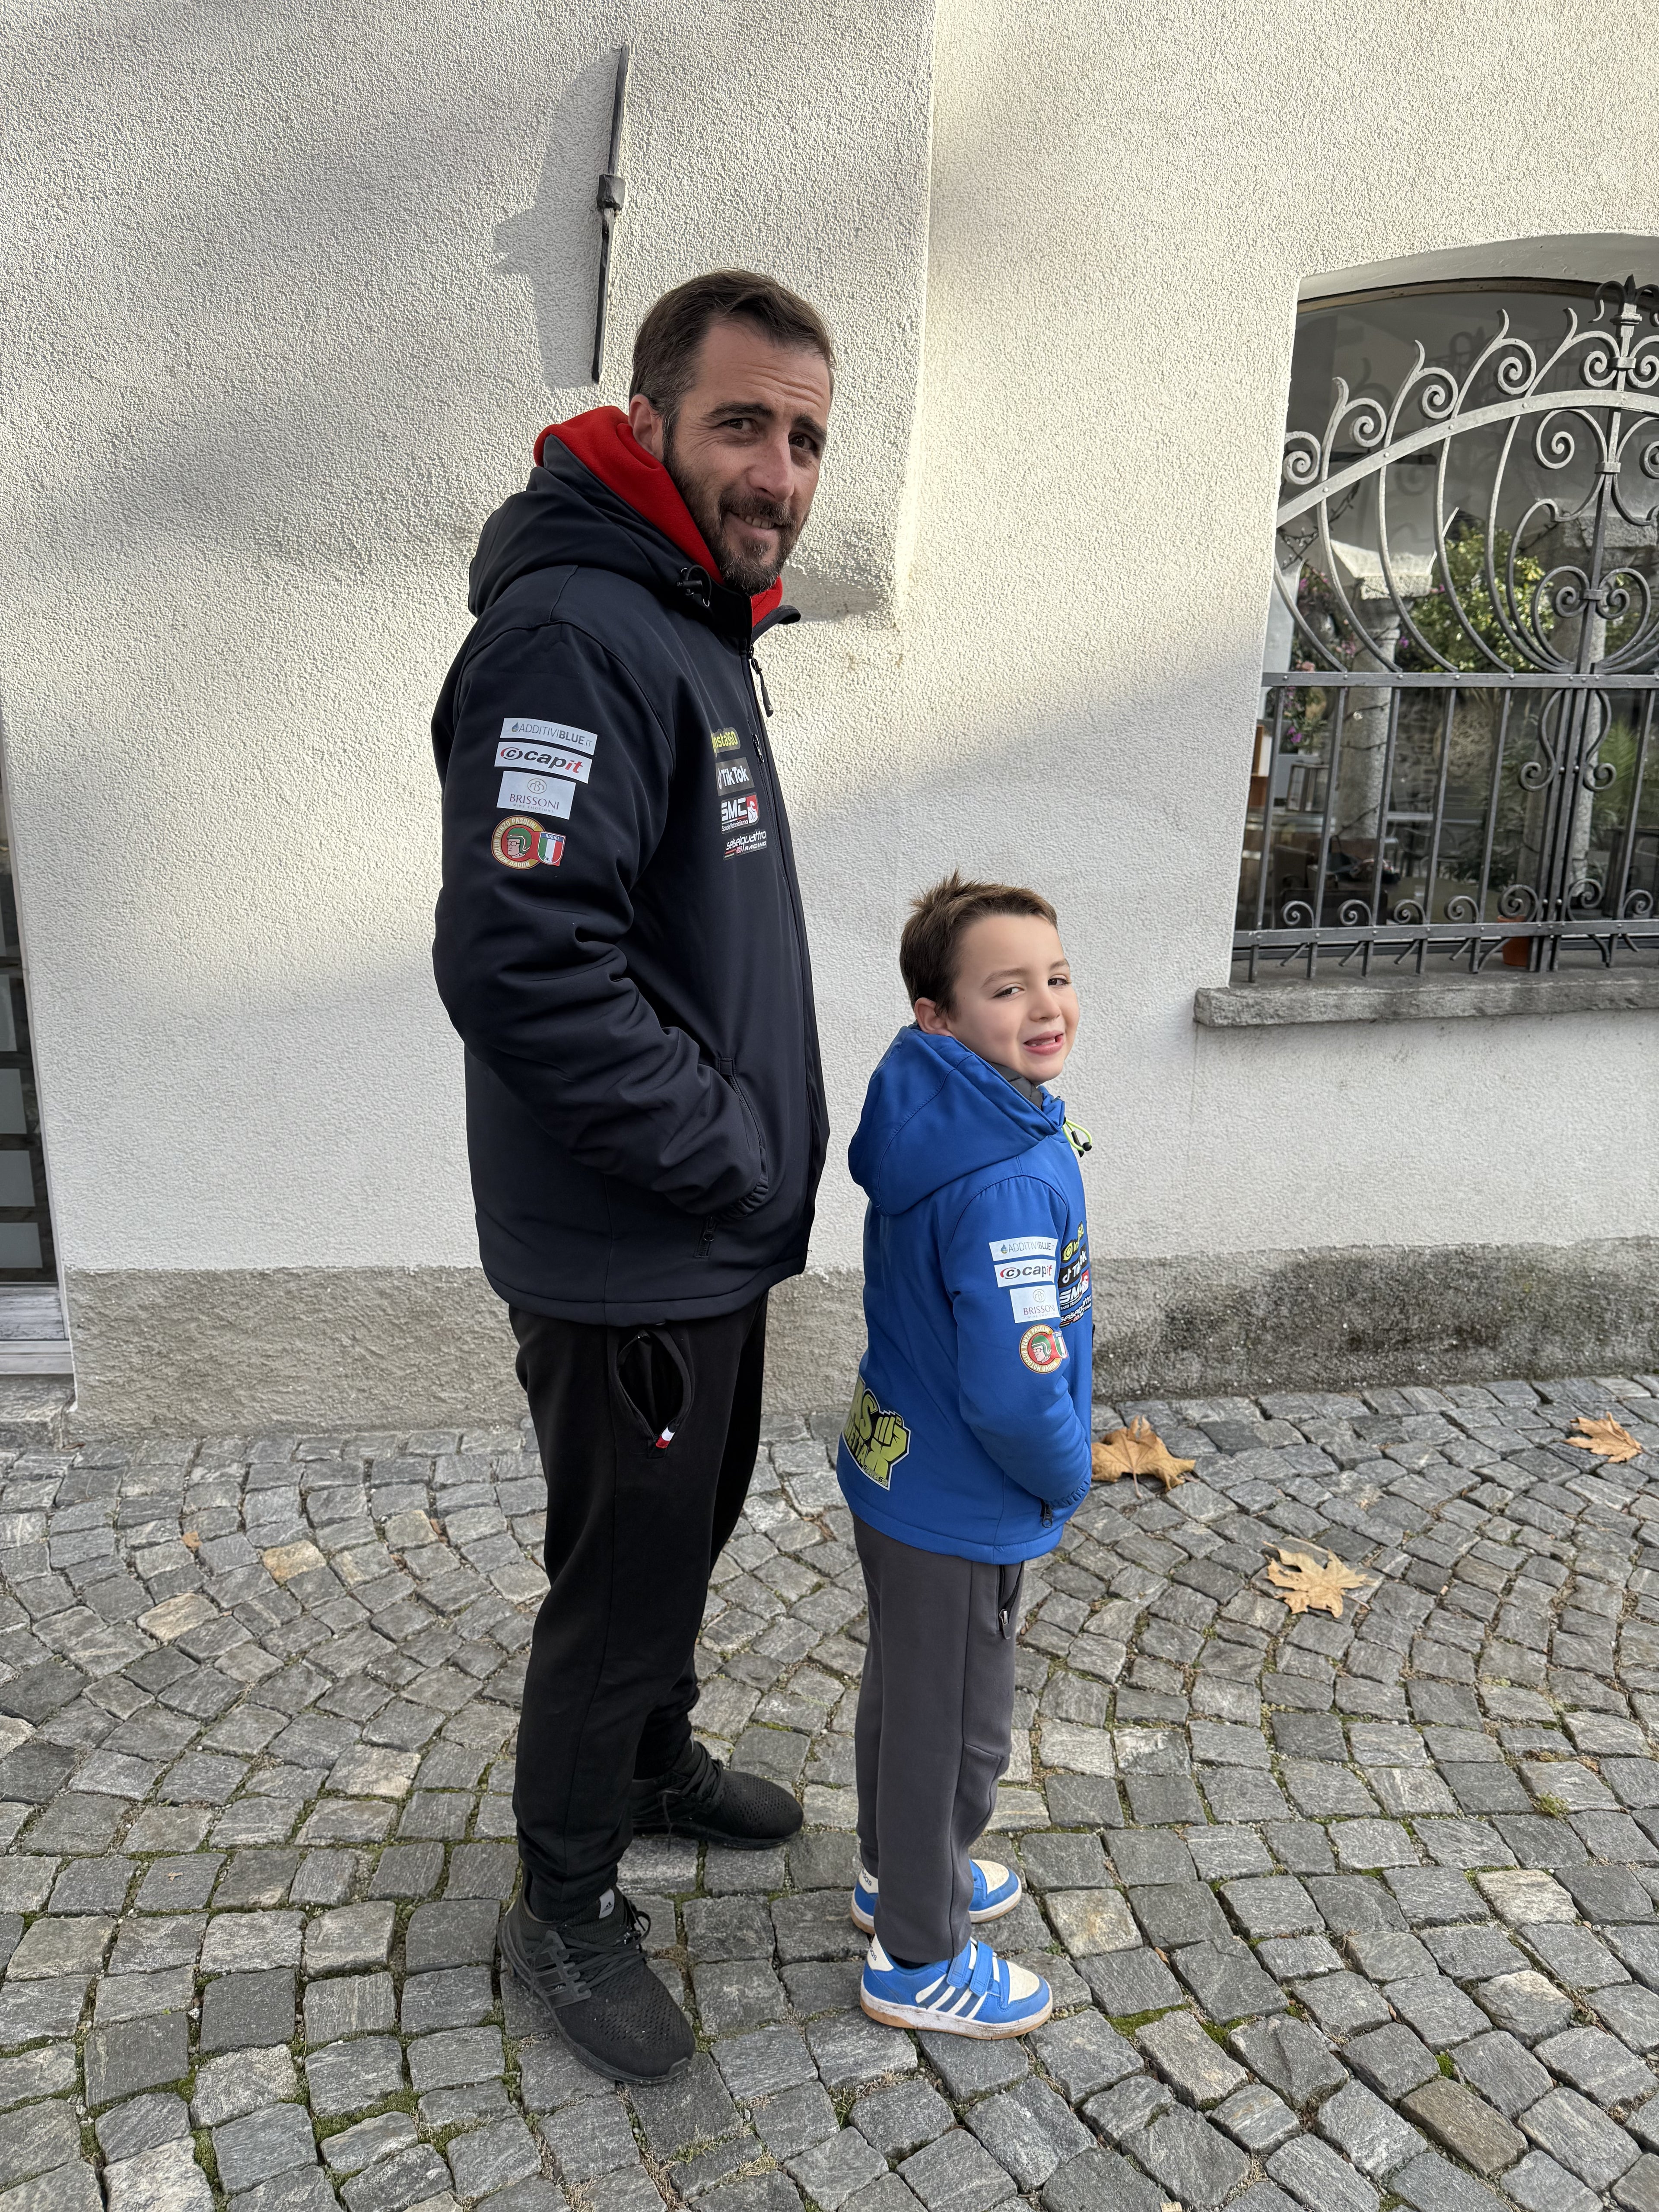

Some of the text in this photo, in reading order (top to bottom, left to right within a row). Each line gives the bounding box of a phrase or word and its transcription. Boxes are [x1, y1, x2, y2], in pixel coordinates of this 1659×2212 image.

[518, 723, 592, 747] ADDITIVIBLUE.IT
[524, 750, 583, 774] capit
[721, 765, 750, 786] TikTok
[509, 793, 559, 810] BRISSONI
[721, 797, 747, 821] SMC
[496, 820, 510, 837] RENZO
[512, 818, 537, 829] PASOLINI
[744, 841, 766, 851] RACING
[1022, 1265, 1052, 1278] capit
[1031, 1326, 1050, 1334] PASOLINI
[1022, 1332, 1032, 1349] RENZO
[1022, 1350, 1041, 1371] MOTOCLUB
